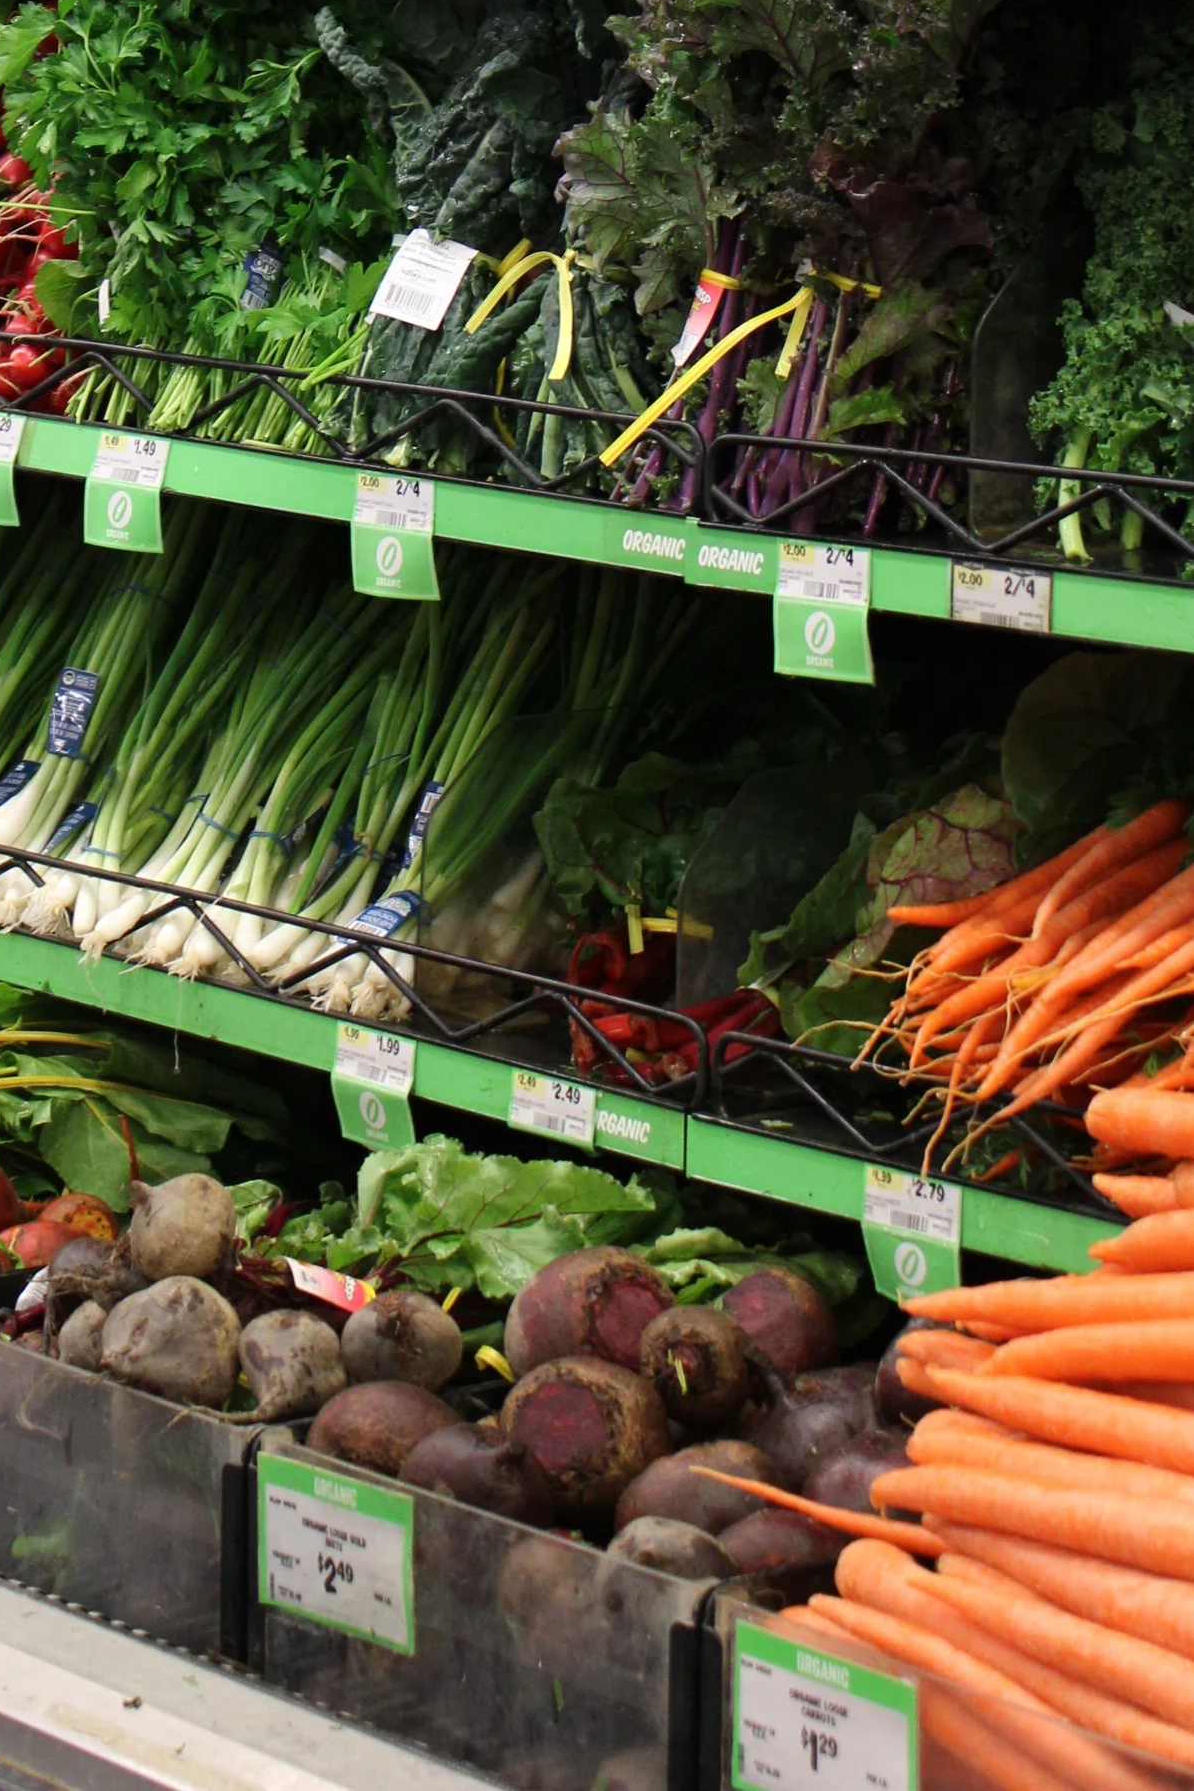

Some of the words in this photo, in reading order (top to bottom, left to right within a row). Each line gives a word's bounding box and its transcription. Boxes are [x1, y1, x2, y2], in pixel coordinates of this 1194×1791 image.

[622, 528, 686, 560] ORGANIC
[698, 544, 765, 575] ORGANIC
[377, 1034, 400, 1056] $1.99
[552, 1081, 581, 1105] $2.49
[912, 1177, 945, 1202] $2.79
[796, 1650, 850, 1690] ORGANIC
